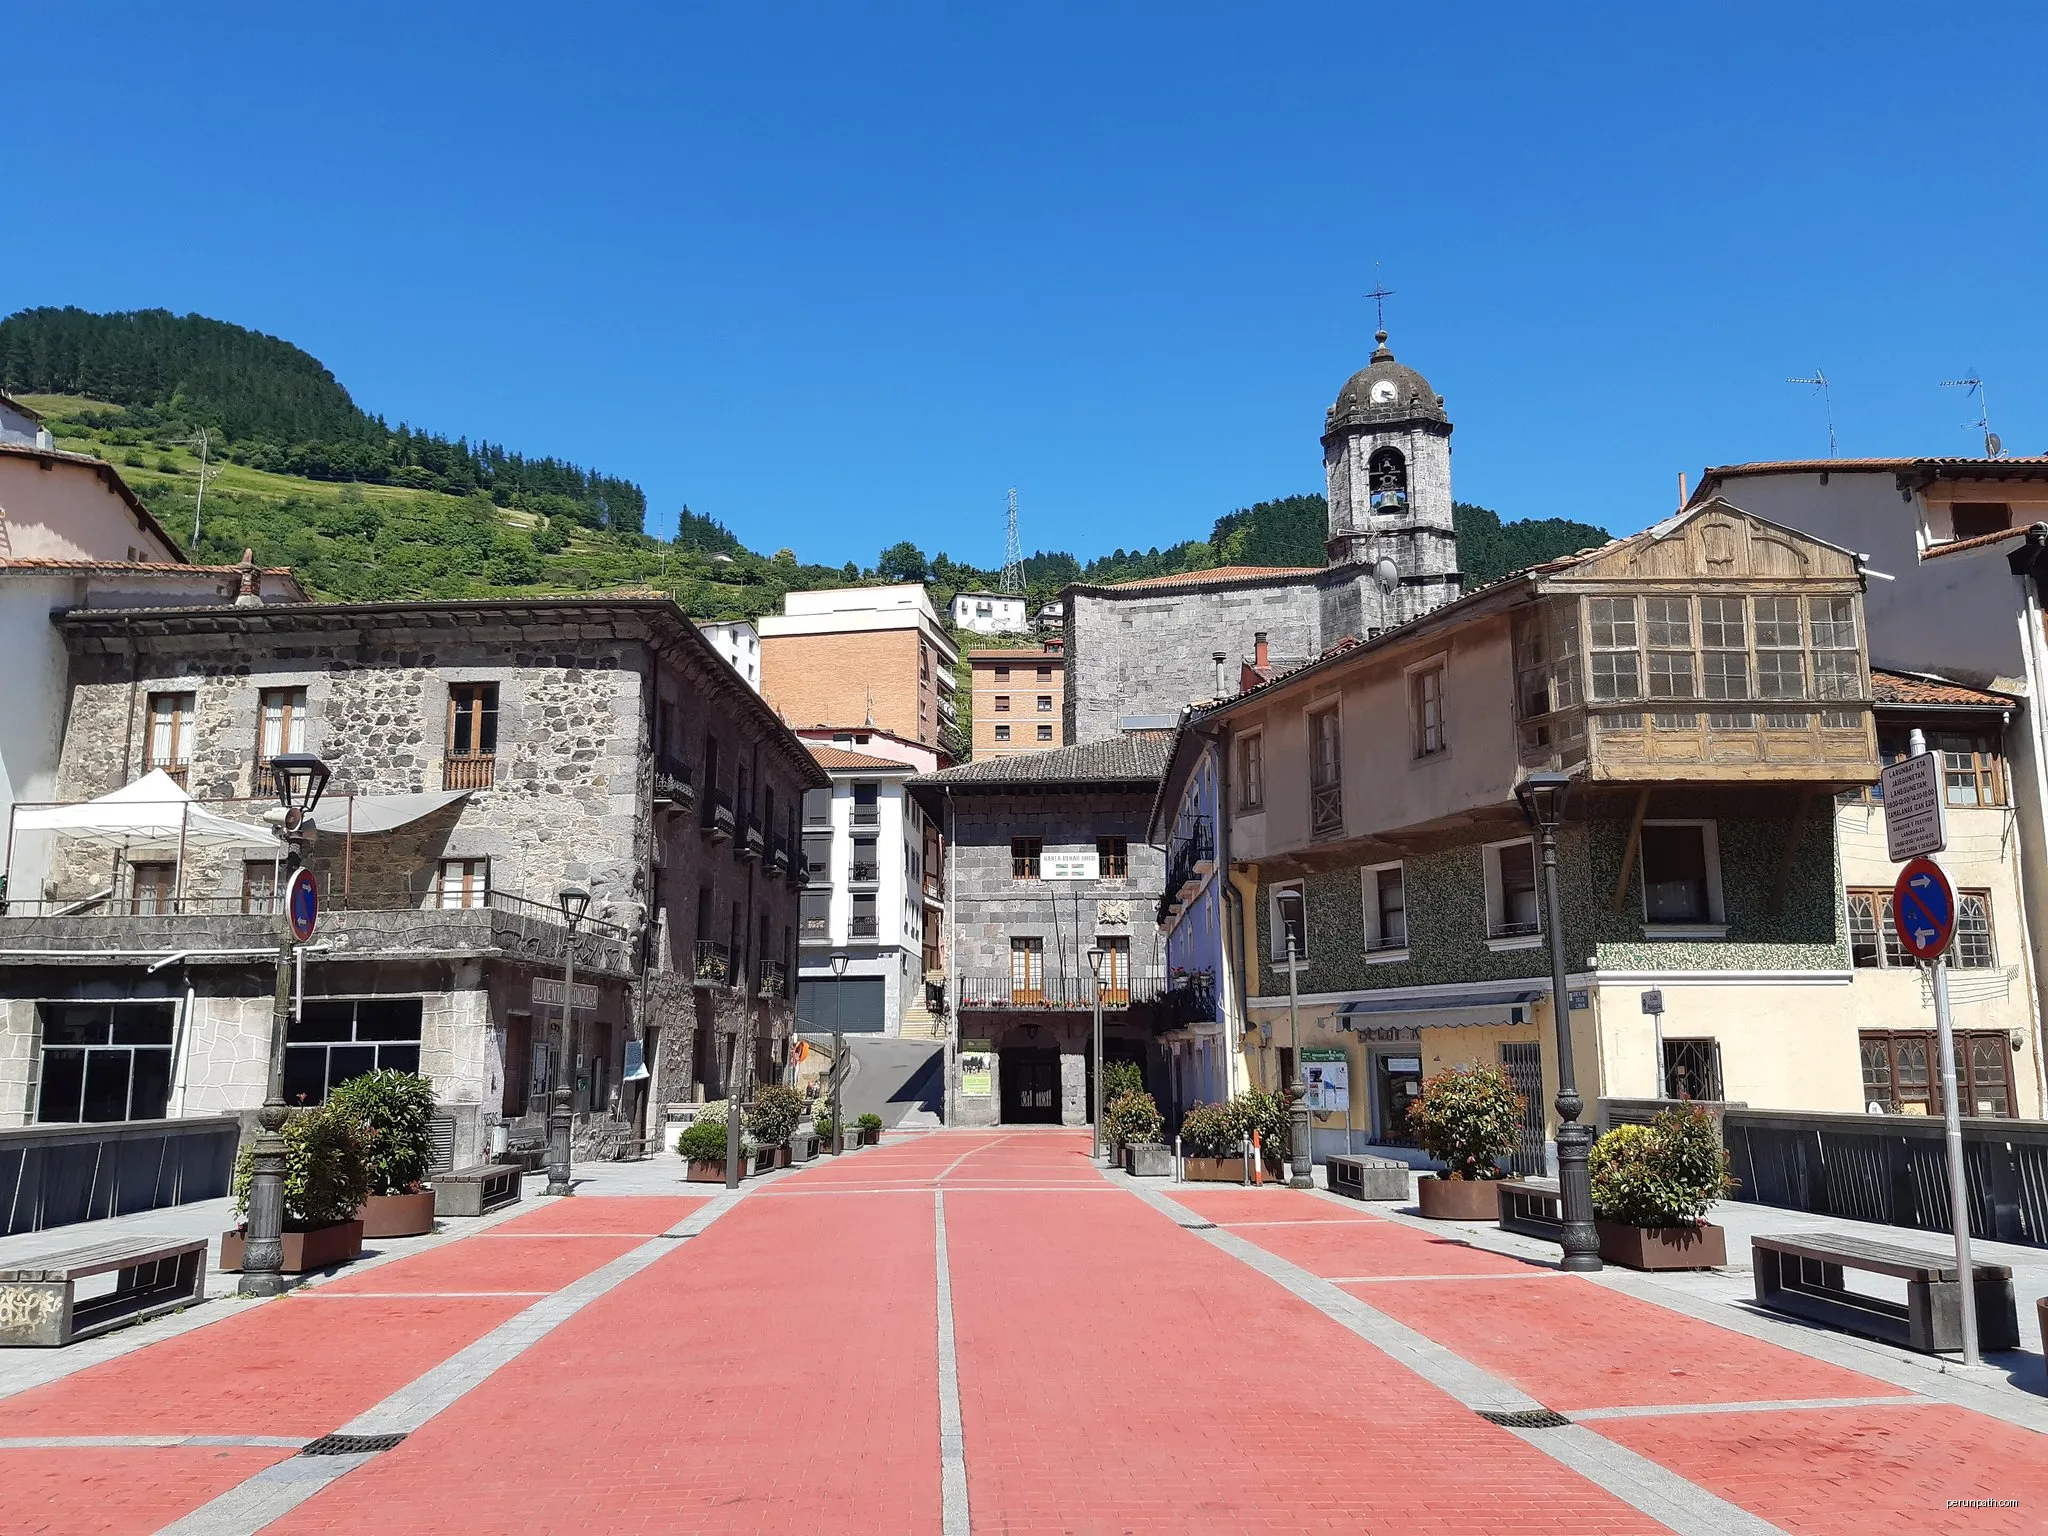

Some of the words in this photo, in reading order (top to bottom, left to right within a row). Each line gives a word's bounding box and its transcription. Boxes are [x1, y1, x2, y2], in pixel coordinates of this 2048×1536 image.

[1889, 764, 1914, 778] LARUNBAT
[1917, 760, 1926, 769] ETA
[1892, 771, 1925, 788] JAIEGUNETAN
[1890, 780, 1928, 798] LANEGUNETAN:
[1887, 804, 1914, 819] ZAMALANAK
[1914, 801, 1926, 812] IZAN
[1926, 798, 1936, 809] EZIK
[1915, 816, 1932, 826] FESTIVOS
[1906, 845, 1918, 854] CARGA
[533, 982, 565, 1001] JUVENTU
[571, 986, 597, 1006] ONZAGA
